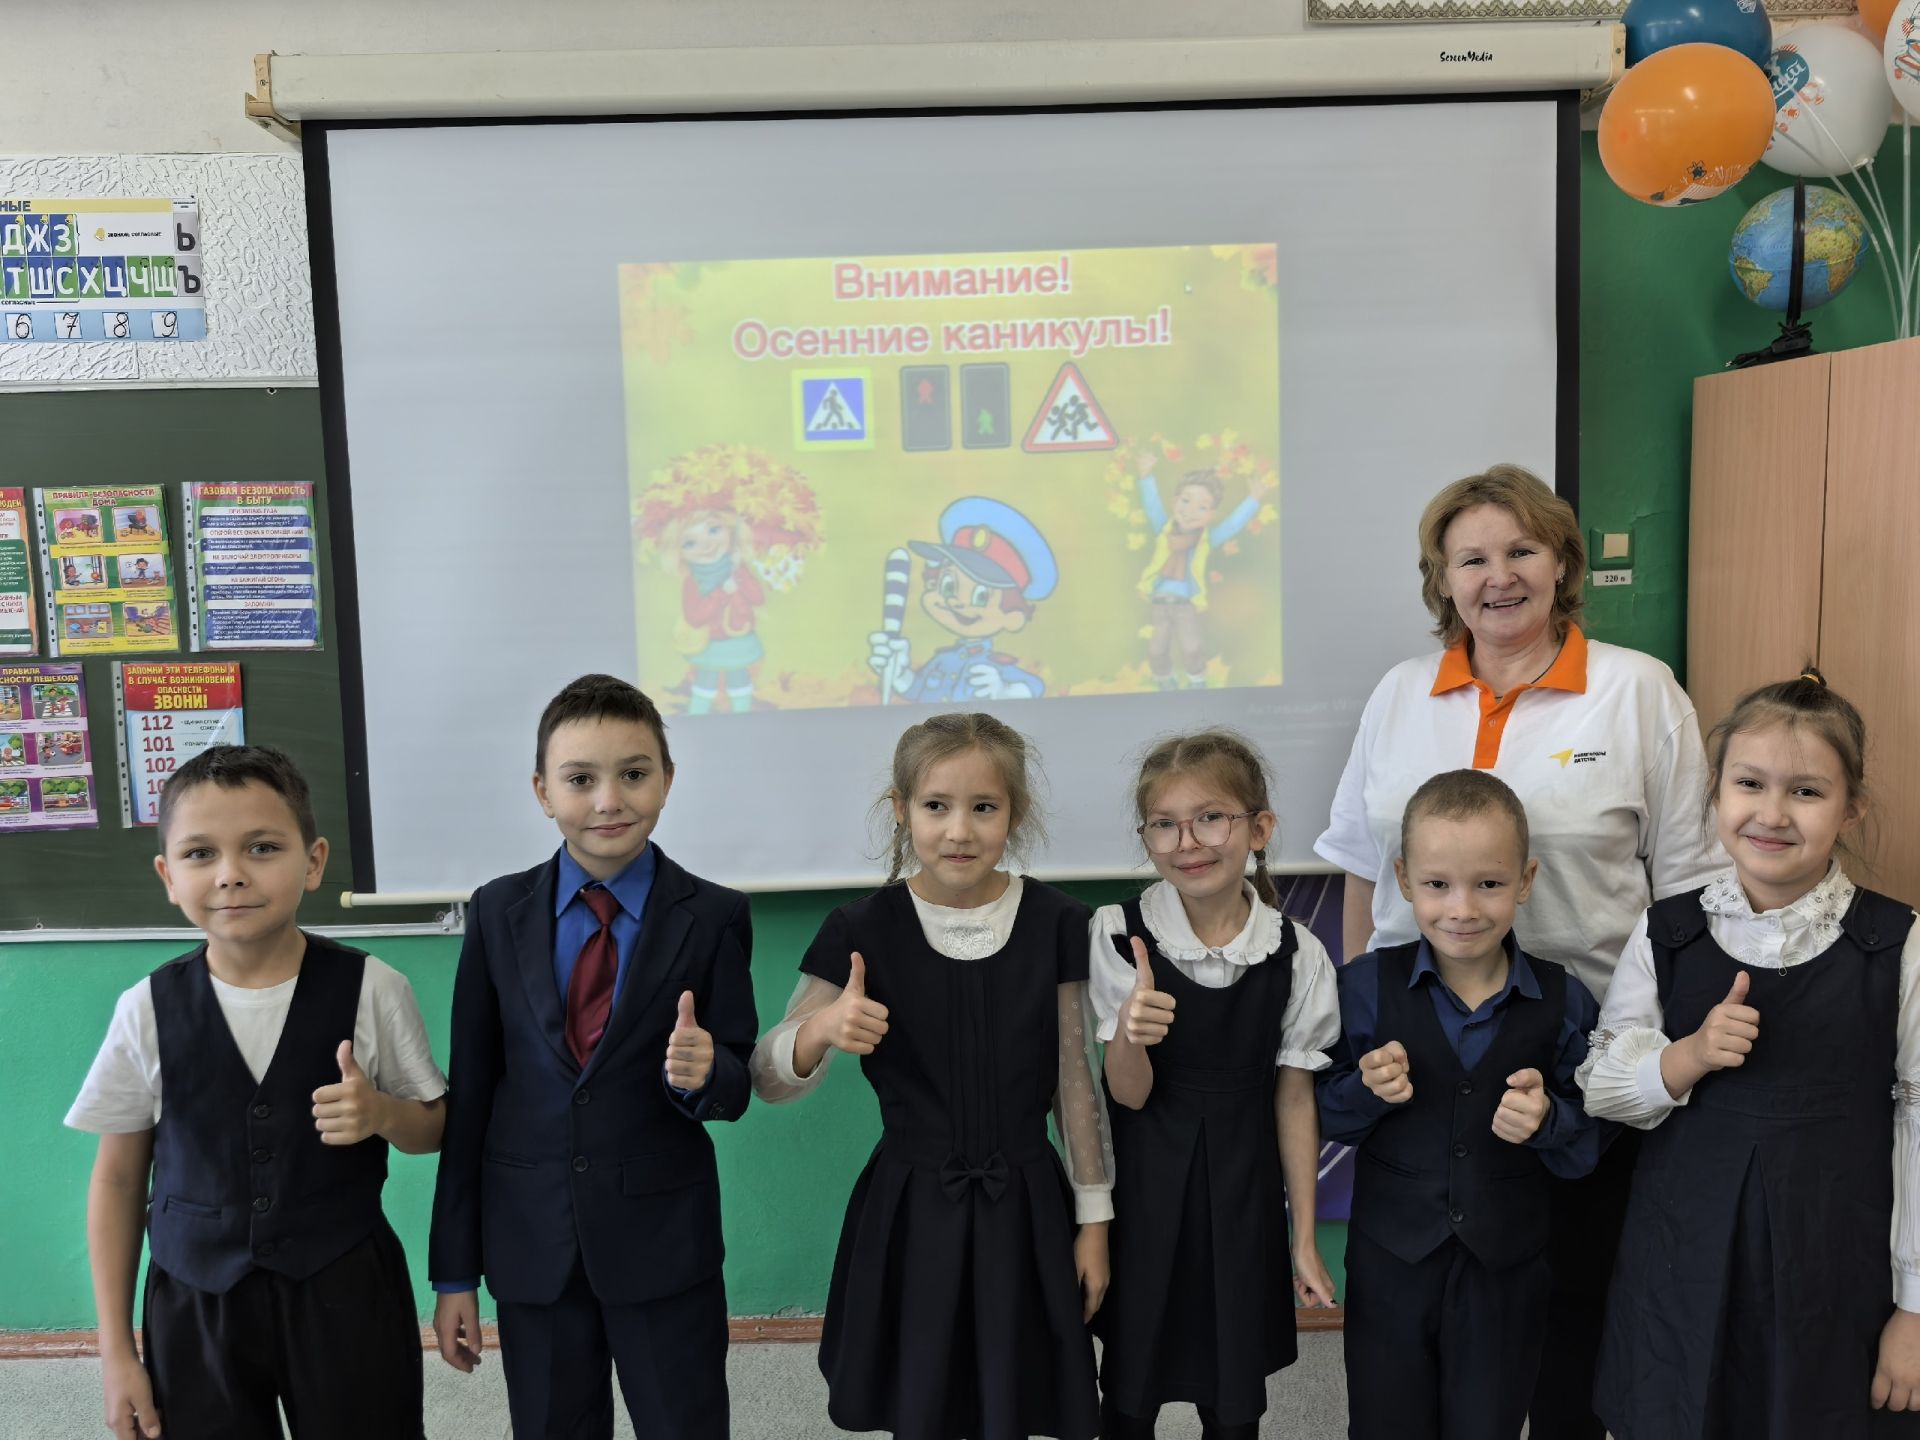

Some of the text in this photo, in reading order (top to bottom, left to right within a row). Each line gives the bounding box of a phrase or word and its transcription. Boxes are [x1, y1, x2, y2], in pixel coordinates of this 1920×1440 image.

[833, 255, 1070, 300] Внимание!
[15, 311, 178, 339] 6 7 8 9
[732, 307, 1170, 360] Осенние каникулы!
[52, 489, 154, 499] ПРАВИЛА БЕЗОПАСНОСТИ
[199, 486, 306, 496] ГАЗОВАЯ БЕЗОПАСНОСТЬ
[92, 498, 116, 506] ДОМА
[237, 496, 272, 505] В БЫТУ
[2, 667, 41, 675] ПРАВИЛА
[127, 666, 164, 674] ЗАПОМНИ
[166, 666, 180, 674] ЭТИ
[183, 666, 227, 674] ТЕЛЕФОНЫ
[34, 675, 79, 683] ПЕШЕХОДА
[137, 676, 167, 685] СЛУЧАЕ
[170, 675, 235, 684] ВОЗНИКНОВЕНИЯ
[157, 686, 202, 694] ОПАСНОСТИ
[153, 694, 208, 710] ЗВОНИ!
[141, 715, 174, 731] 112
[143, 736, 175, 752] 101
[145, 757, 177, 773] 102
